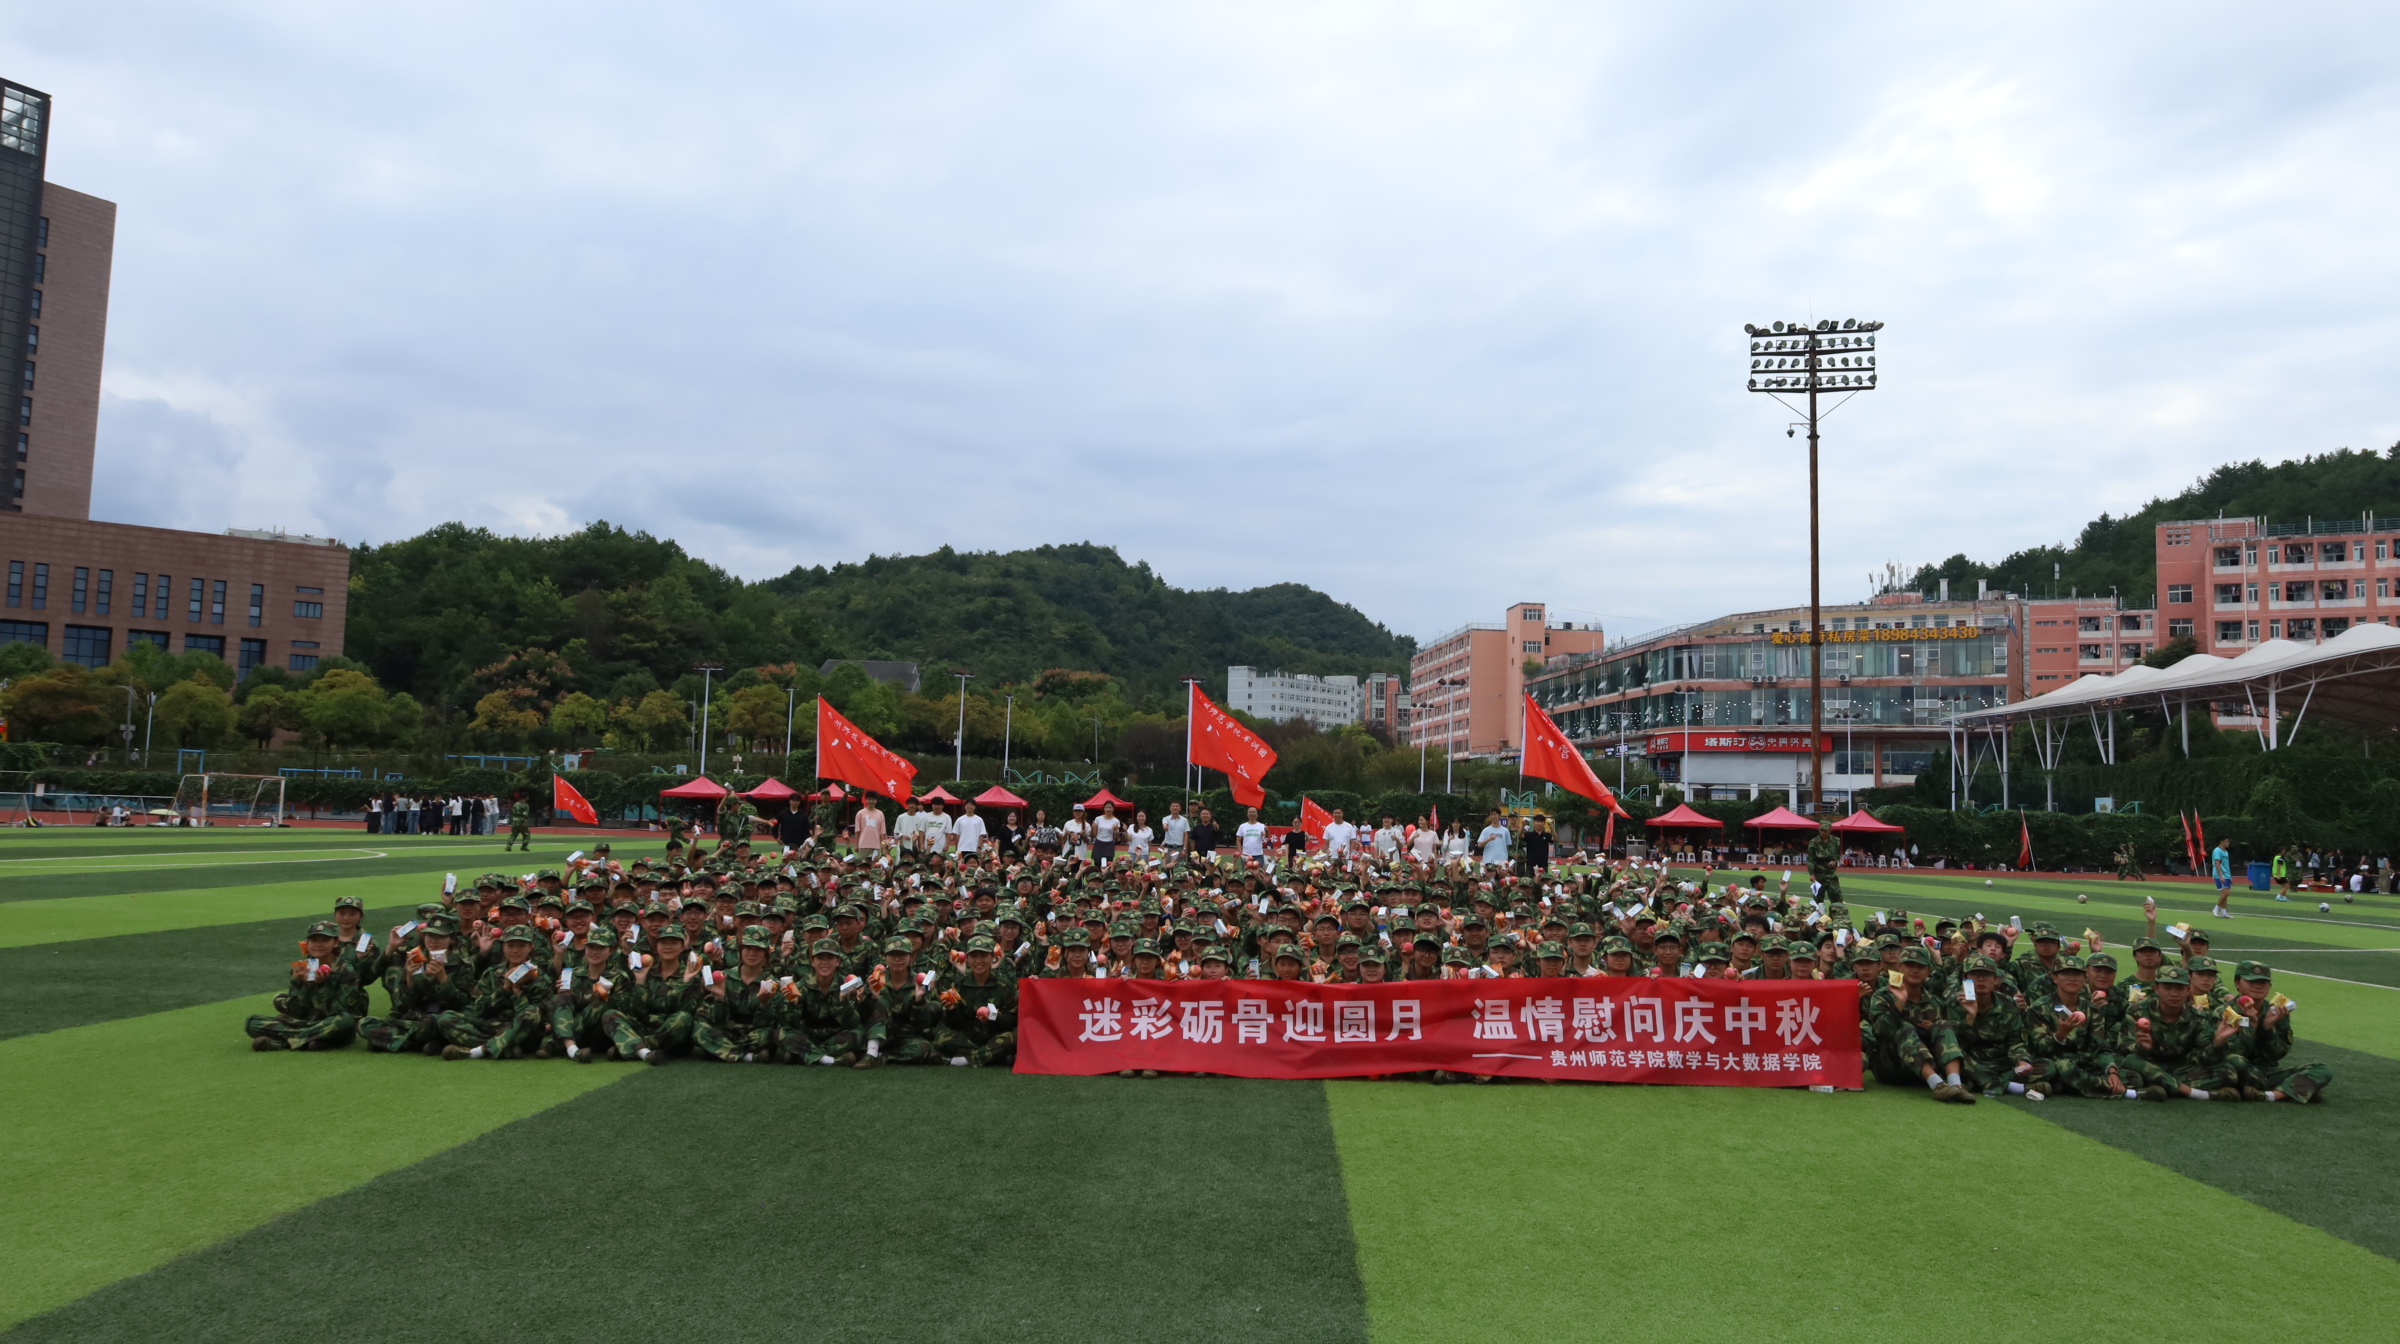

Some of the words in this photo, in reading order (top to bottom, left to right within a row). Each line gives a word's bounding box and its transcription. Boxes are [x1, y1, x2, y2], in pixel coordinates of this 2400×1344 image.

[1704, 737, 1747, 747] 塔斯汀
[1078, 997, 1424, 1044] 迷彩砺骨迎圆月
[1472, 995, 1823, 1046] 温情慰问庆中秋
